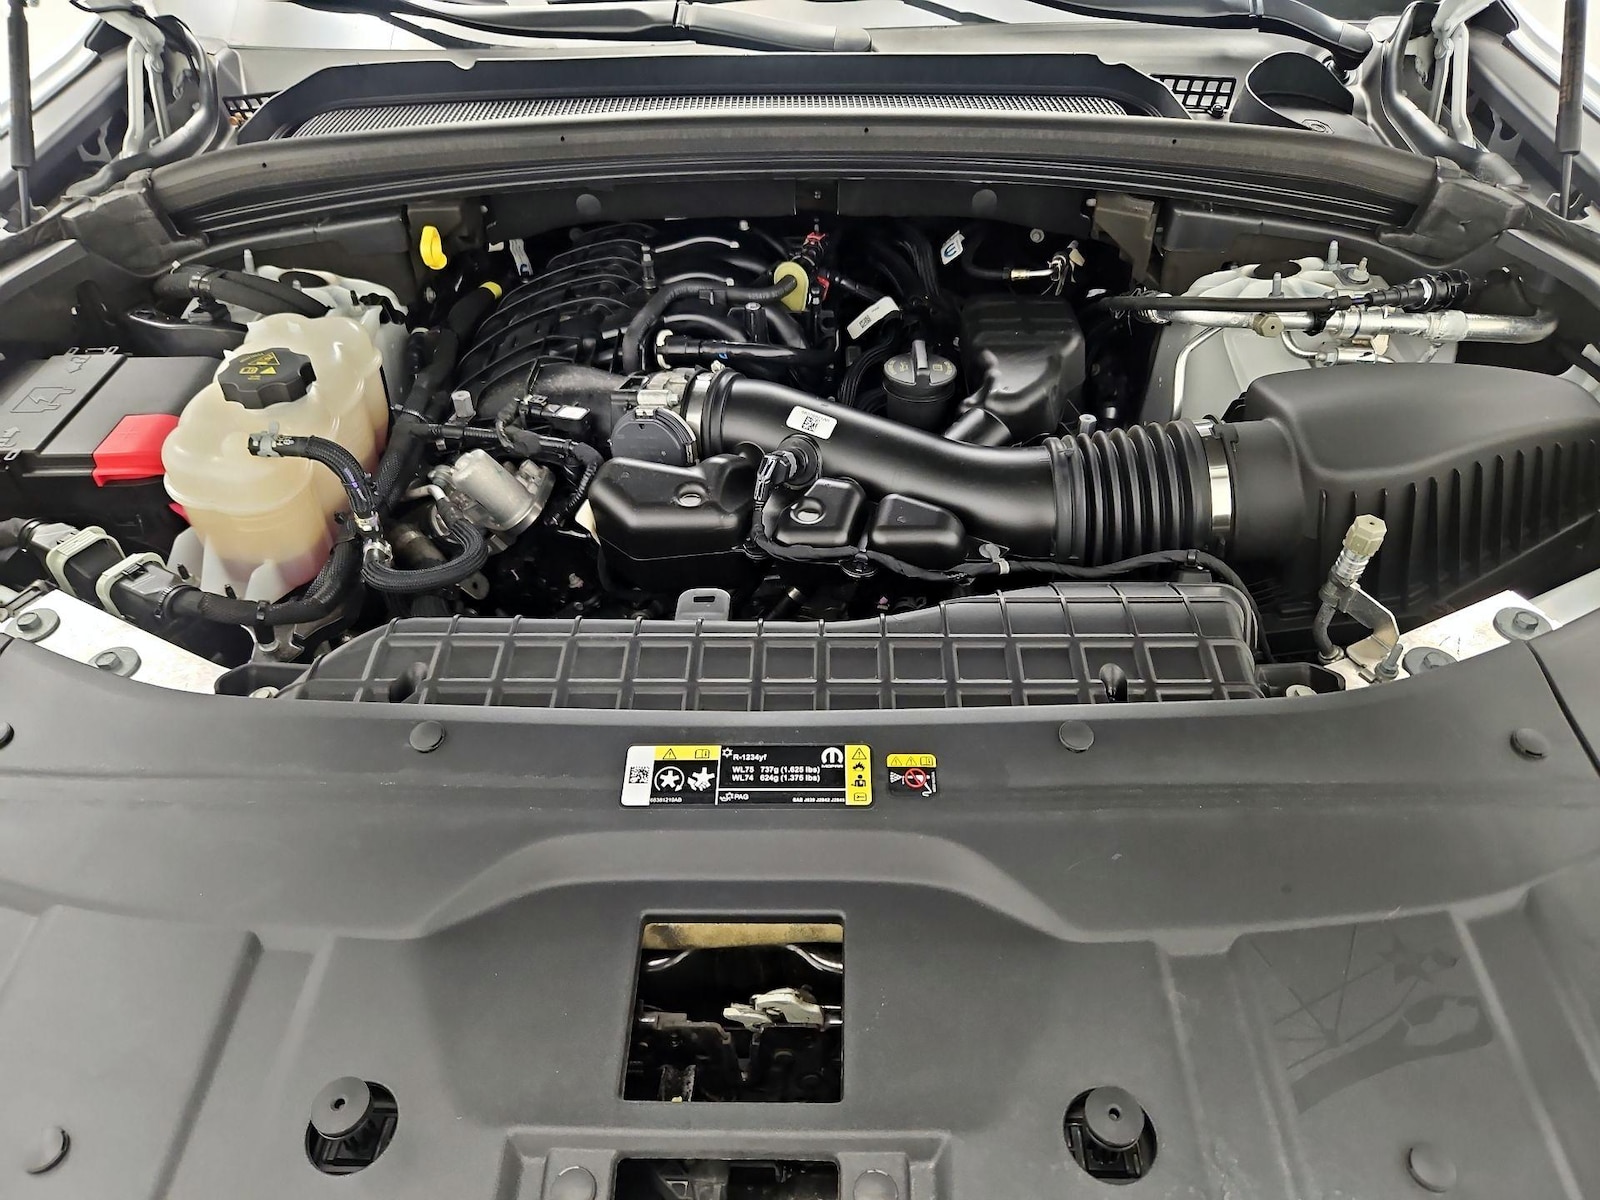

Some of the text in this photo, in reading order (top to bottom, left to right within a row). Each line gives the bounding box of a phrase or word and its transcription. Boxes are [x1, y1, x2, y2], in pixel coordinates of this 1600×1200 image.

[733, 753, 767, 762] R-1234yf
[760, 766, 779, 774] 737g
[780, 765, 804, 774] (1.625
[805, 765, 820, 775] lbs)
[732, 774, 820, 783] WL74 624g (1.375 lbs)
